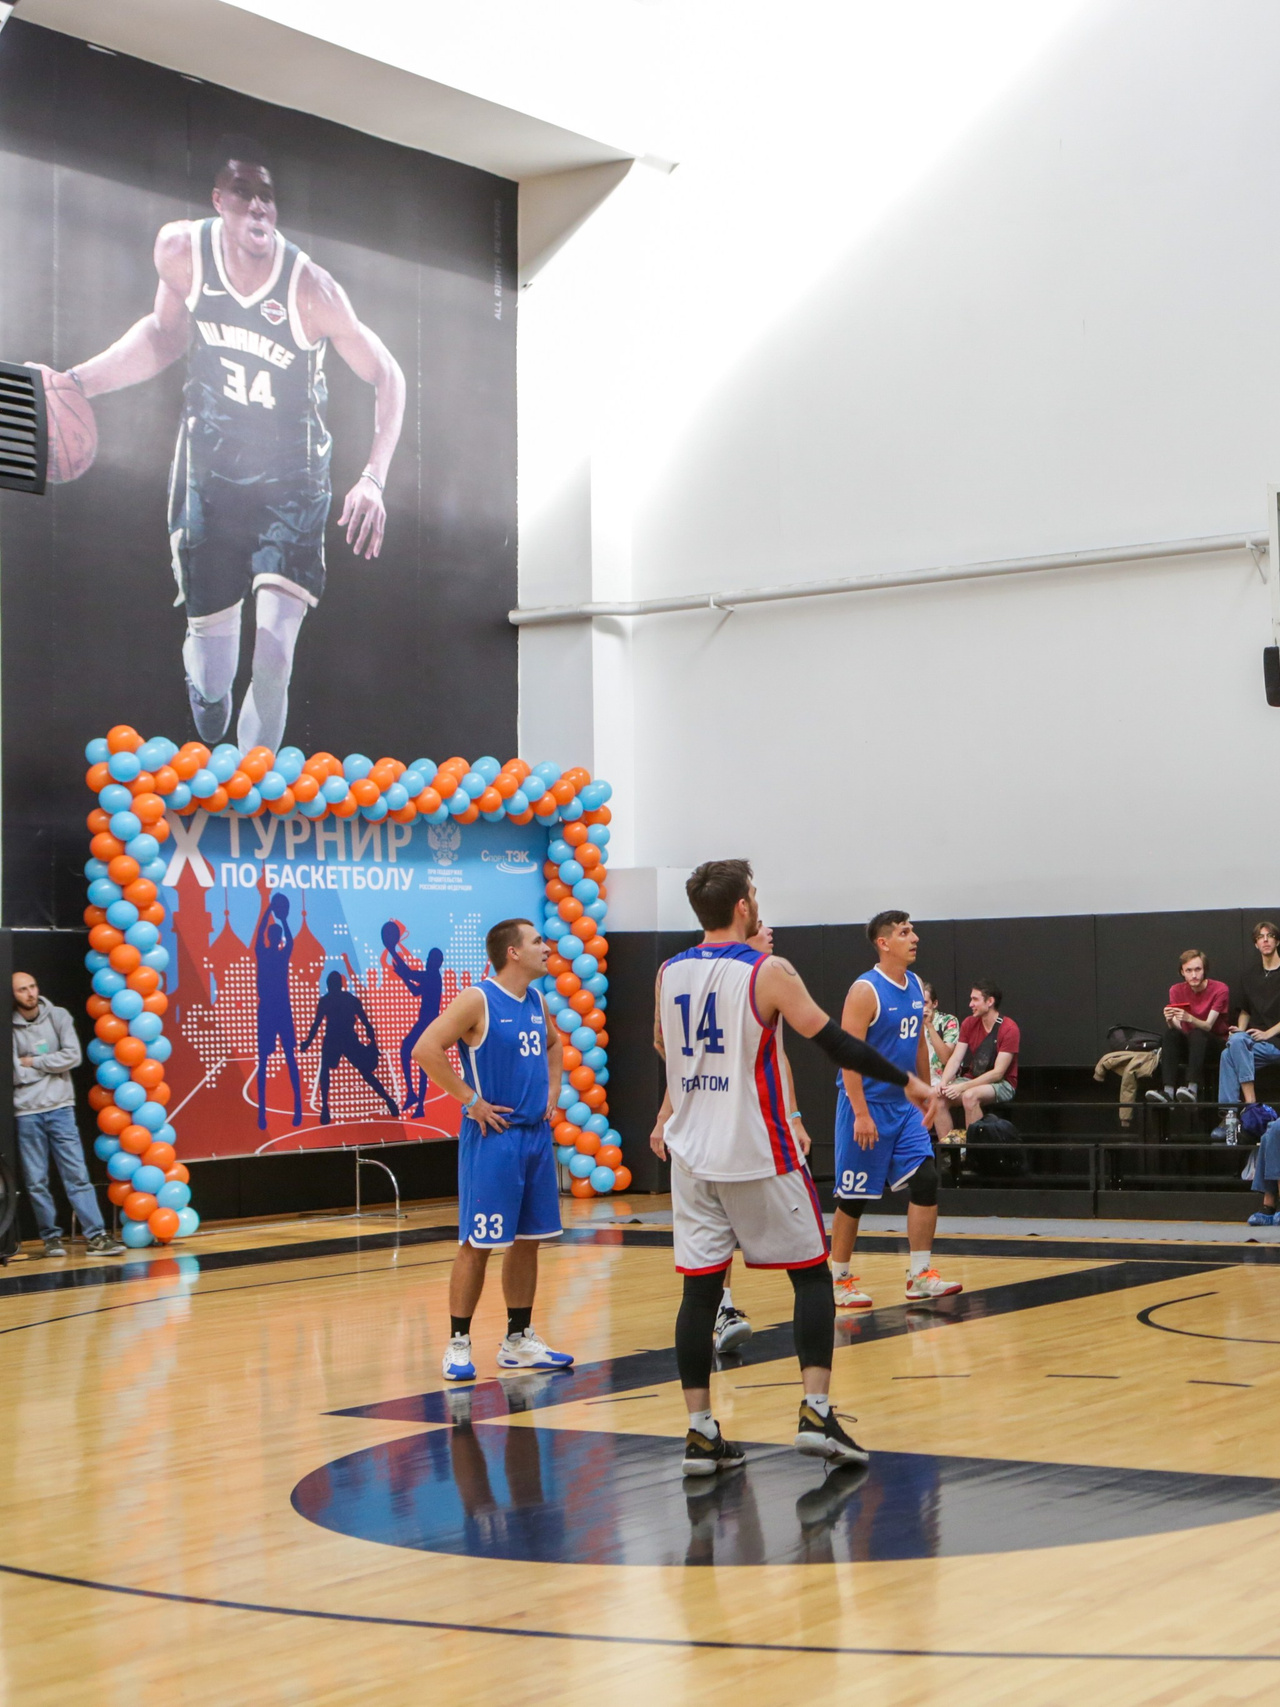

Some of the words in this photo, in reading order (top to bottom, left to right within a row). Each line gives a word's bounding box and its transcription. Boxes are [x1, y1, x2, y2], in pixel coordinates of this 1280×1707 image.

[494, 300, 502, 320] ALL
[220, 357, 276, 410] 34
[220, 809, 413, 863] ТУРНИР
[221, 863, 257, 888] ПО
[265, 864, 414, 891] БАСКЕТБОЛУ
[674, 992, 724, 1057] 14
[899, 1015, 919, 1040] 92
[518, 1030, 542, 1057] 33
[841, 1169, 868, 1193] 92
[473, 1213, 503, 1240] 33
